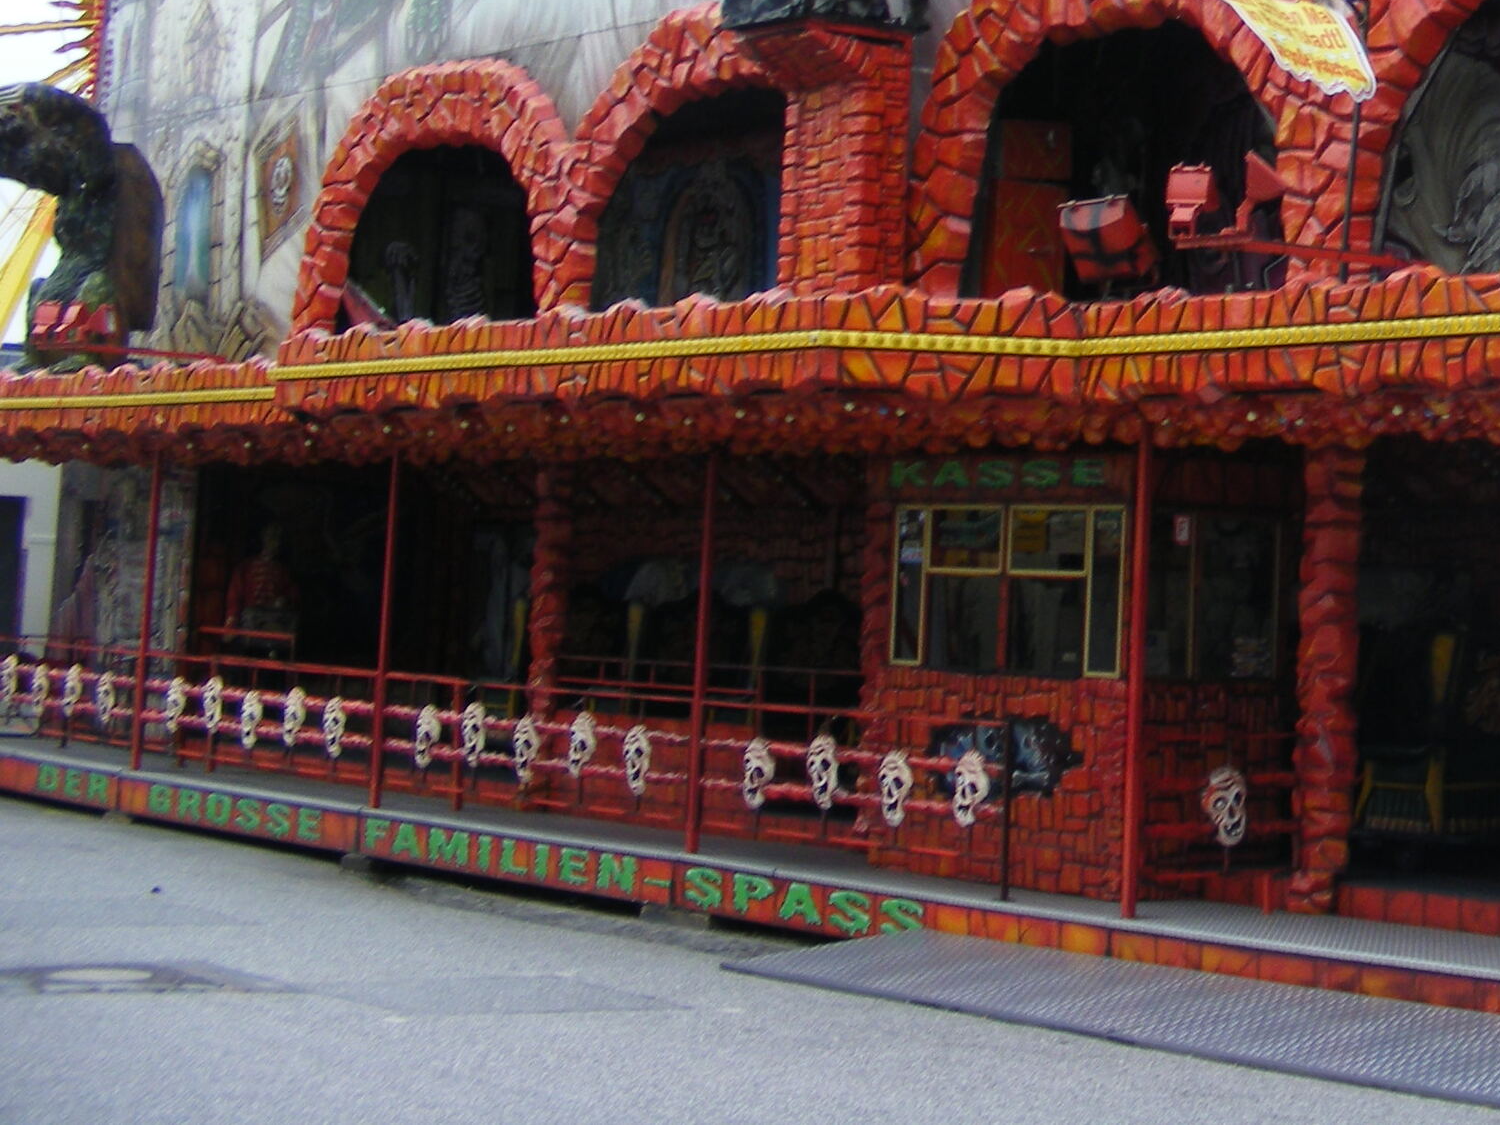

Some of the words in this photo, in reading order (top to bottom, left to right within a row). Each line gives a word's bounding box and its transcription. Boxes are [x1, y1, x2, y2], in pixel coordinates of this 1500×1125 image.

[889, 458, 1106, 488] KASSE
[35, 762, 109, 805] DER
[148, 783, 323, 841] GROSSE
